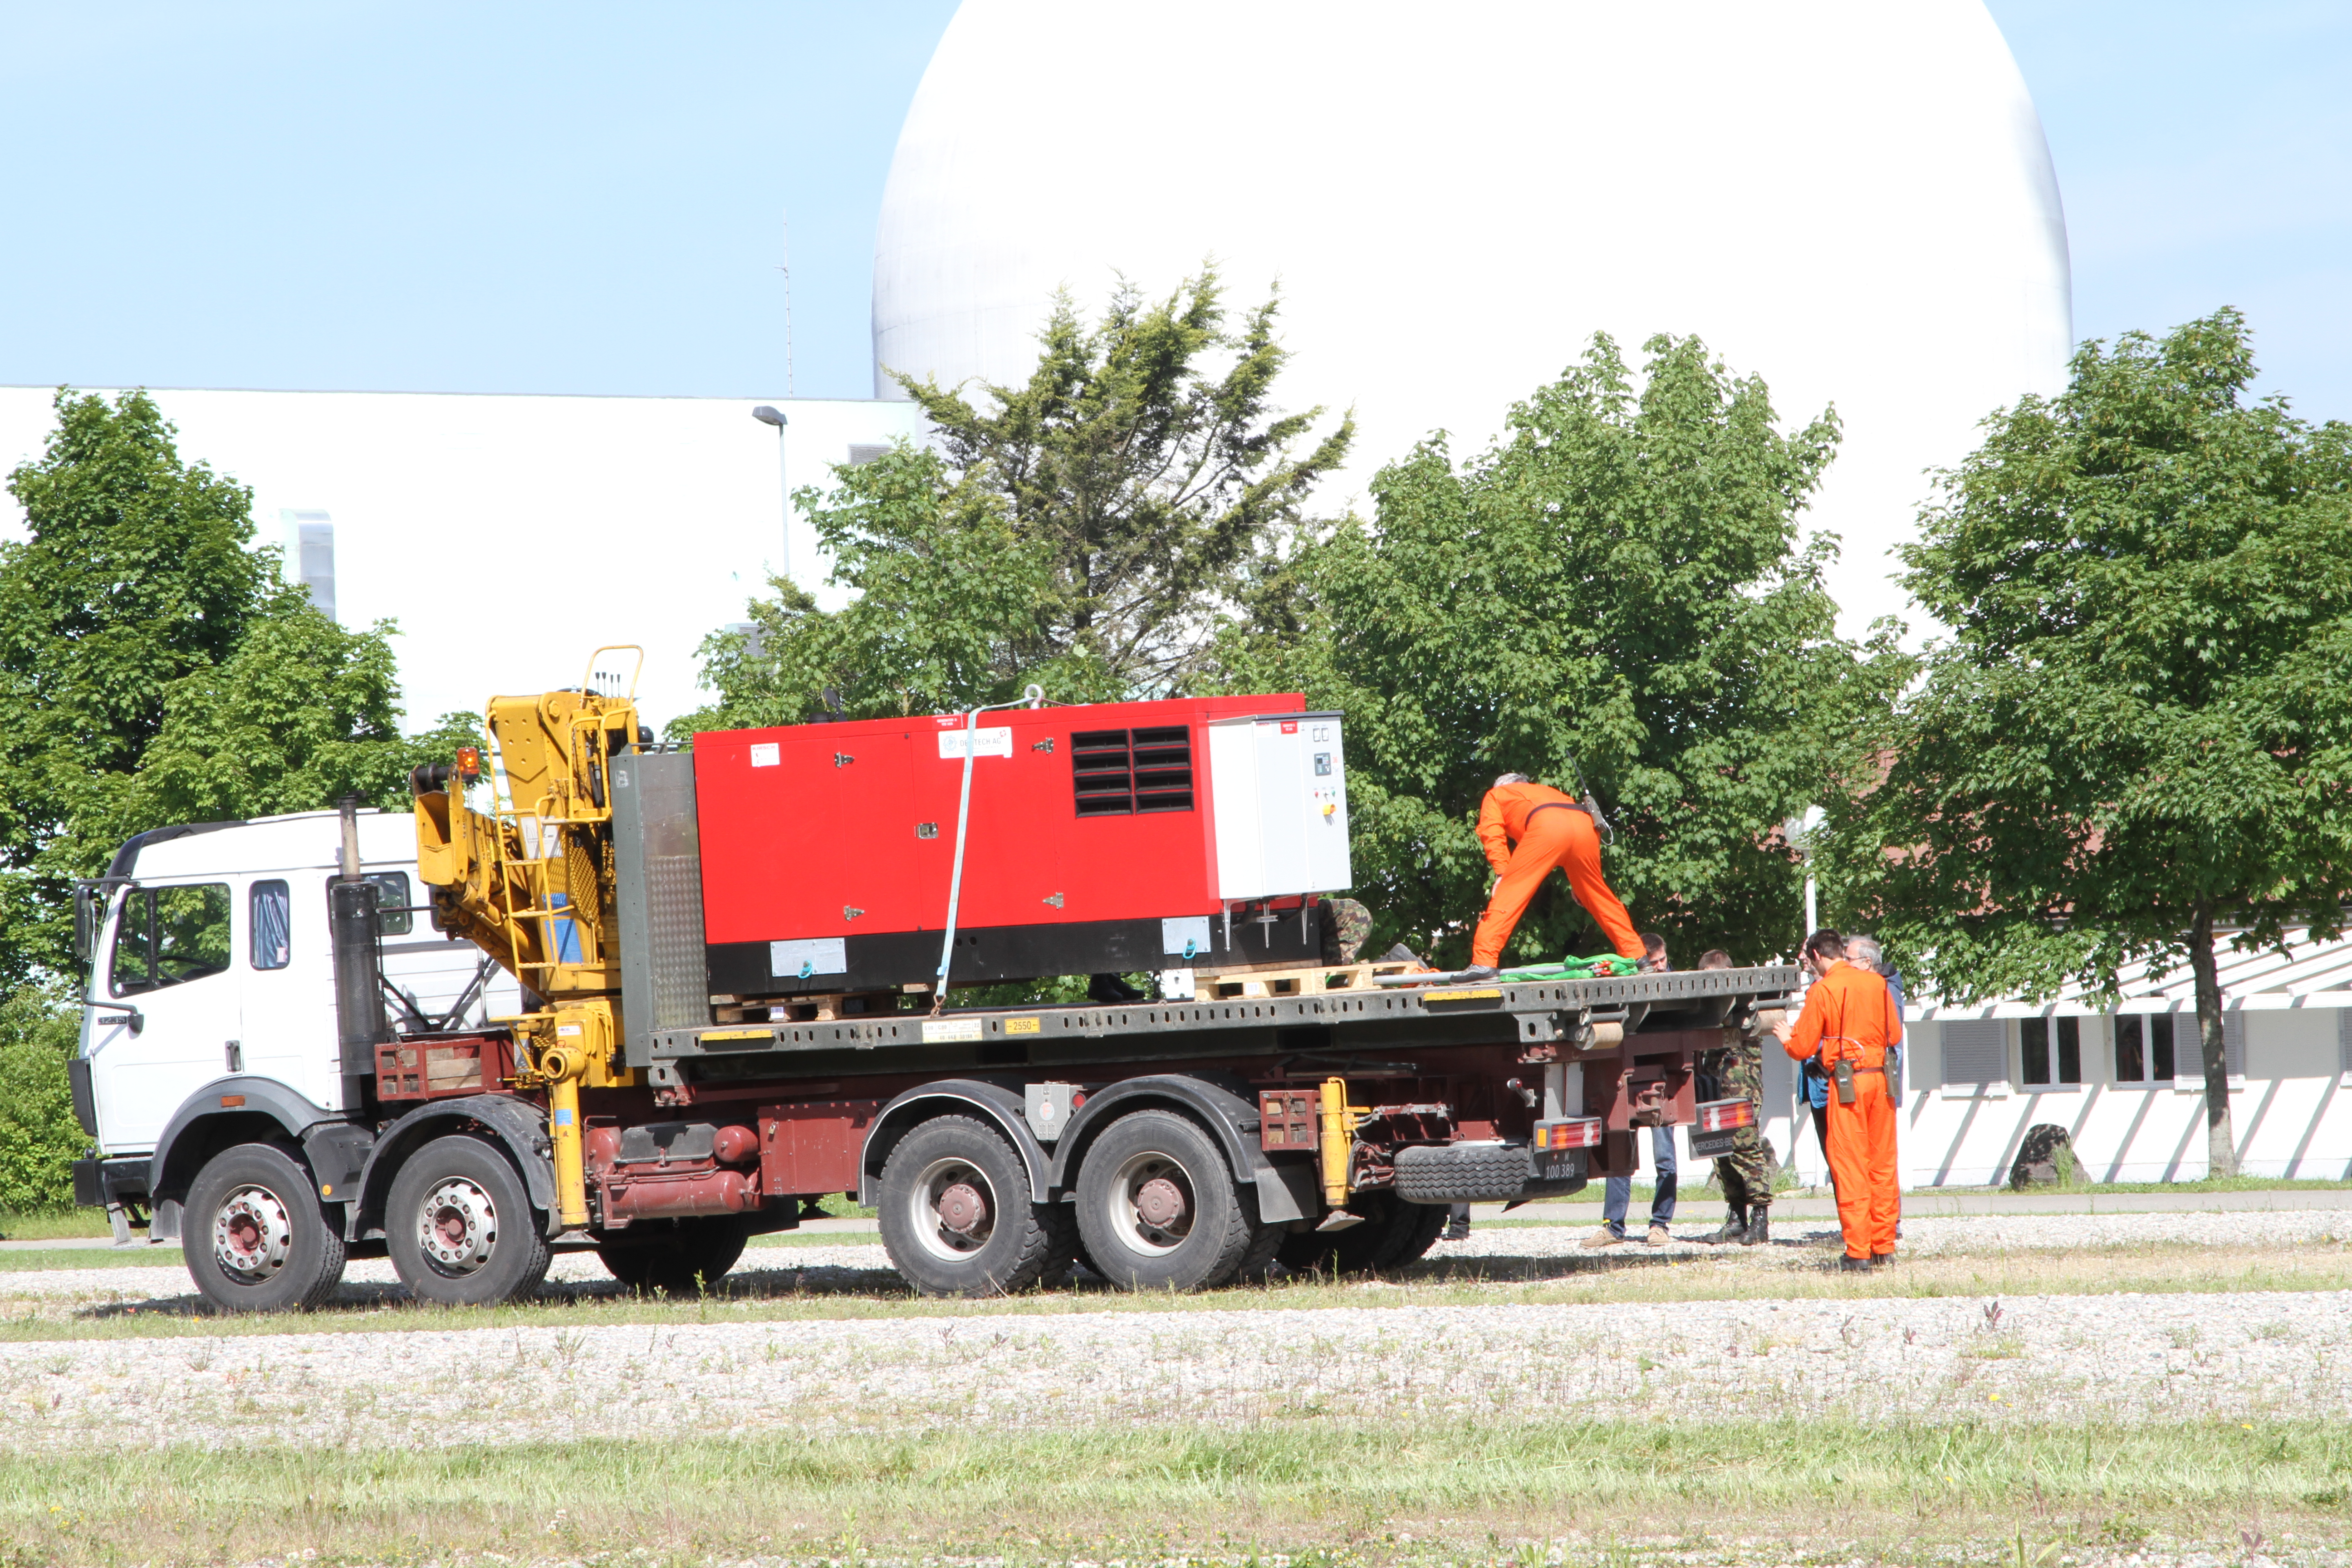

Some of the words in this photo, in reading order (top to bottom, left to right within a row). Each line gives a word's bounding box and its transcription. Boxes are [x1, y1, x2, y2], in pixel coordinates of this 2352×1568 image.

[960, 738, 990, 746] DETECH
[1013, 1020, 1031, 1030] 2550
[1043, 1104, 1051, 1117] F
[1564, 1151, 1569, 1161] M
[1546, 1164, 1559, 1179] 100
[1561, 1163, 1574, 1177] 389
